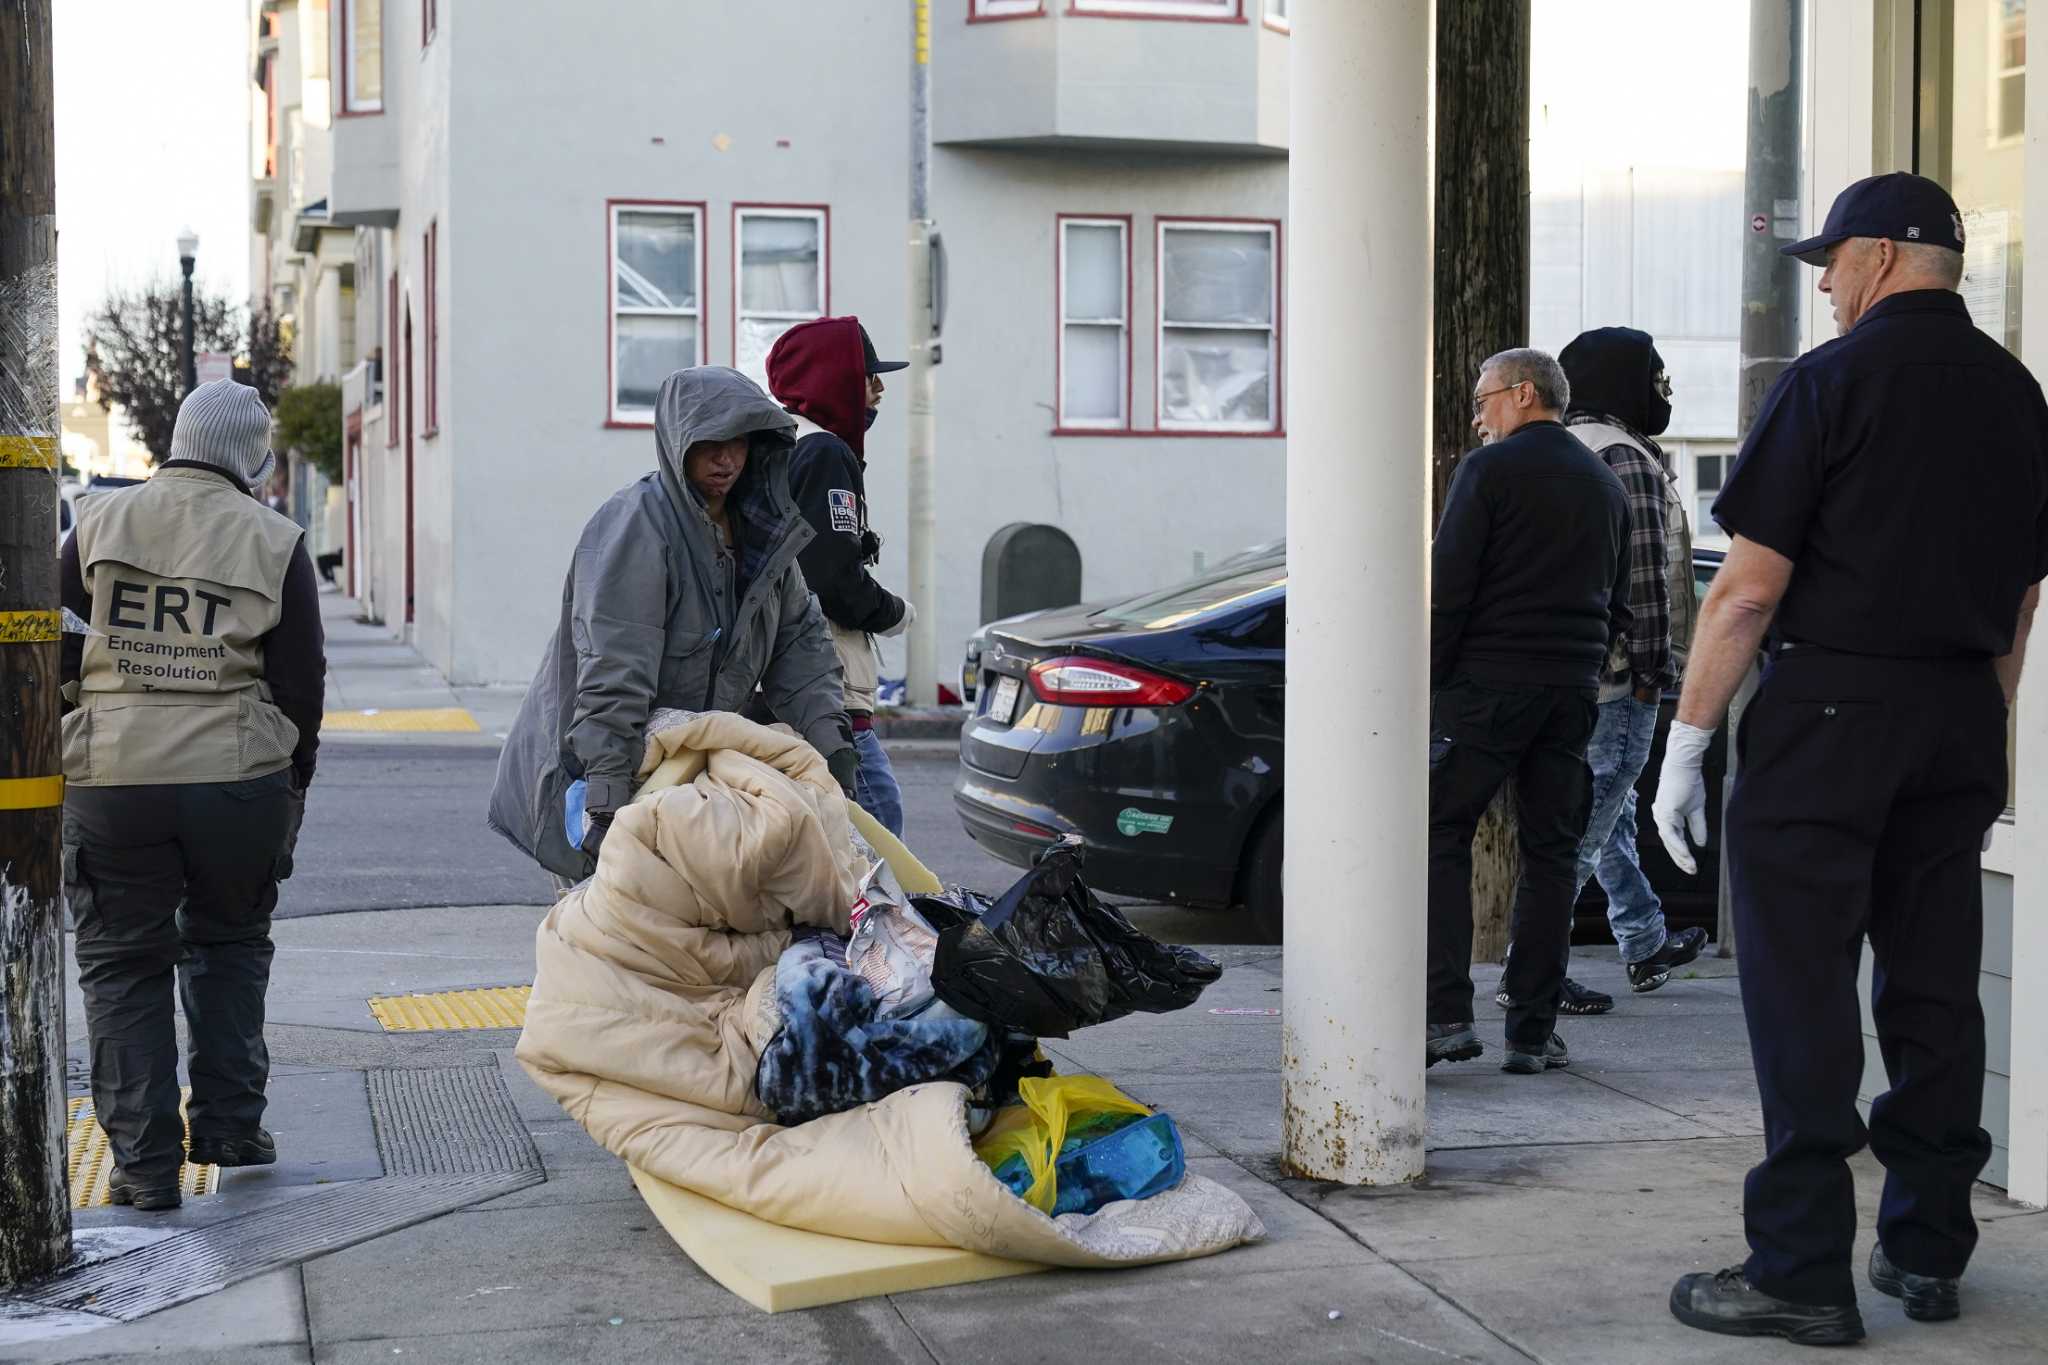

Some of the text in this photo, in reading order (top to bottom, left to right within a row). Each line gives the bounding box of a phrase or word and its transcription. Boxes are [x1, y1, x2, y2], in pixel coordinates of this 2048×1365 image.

[108, 580, 232, 636] ERT
[108, 635, 226, 660] Encampment
[118, 659, 217, 681] Resolution
